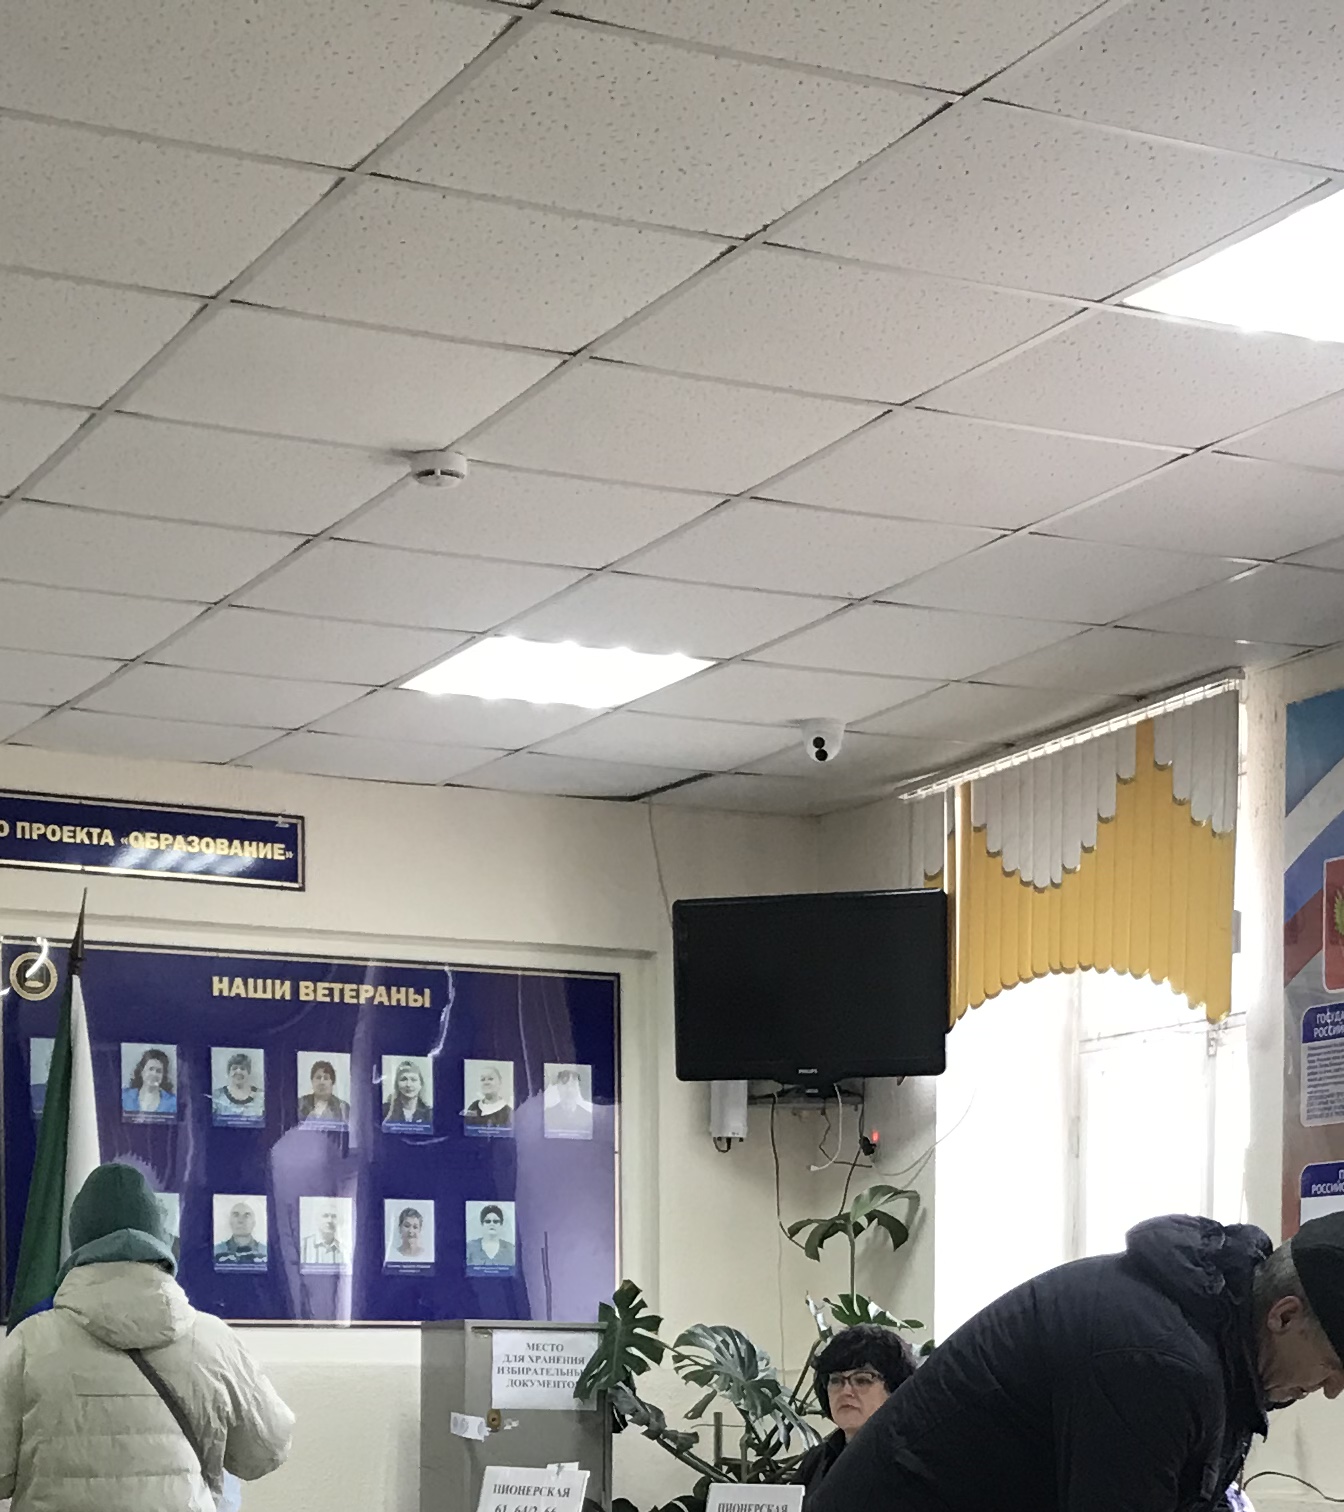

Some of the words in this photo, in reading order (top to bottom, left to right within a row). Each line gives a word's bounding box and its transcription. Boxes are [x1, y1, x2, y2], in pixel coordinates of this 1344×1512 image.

[16, 822, 115, 847] ПРОЕКТА
[212, 976, 292, 1002] НАШИ
[298, 980, 431, 1008] ВЕТЕРАНЫ
[526, 1343, 564, 1352] МЕСТО
[503, 1354, 525, 1363] ДЛЯ
[528, 1355, 586, 1365] ХРАНЕНИЯ
[506, 1379, 577, 1389] ДОКУМЕНТО
[493, 1483, 571, 1498] ПИОНЕРСКАЯ
